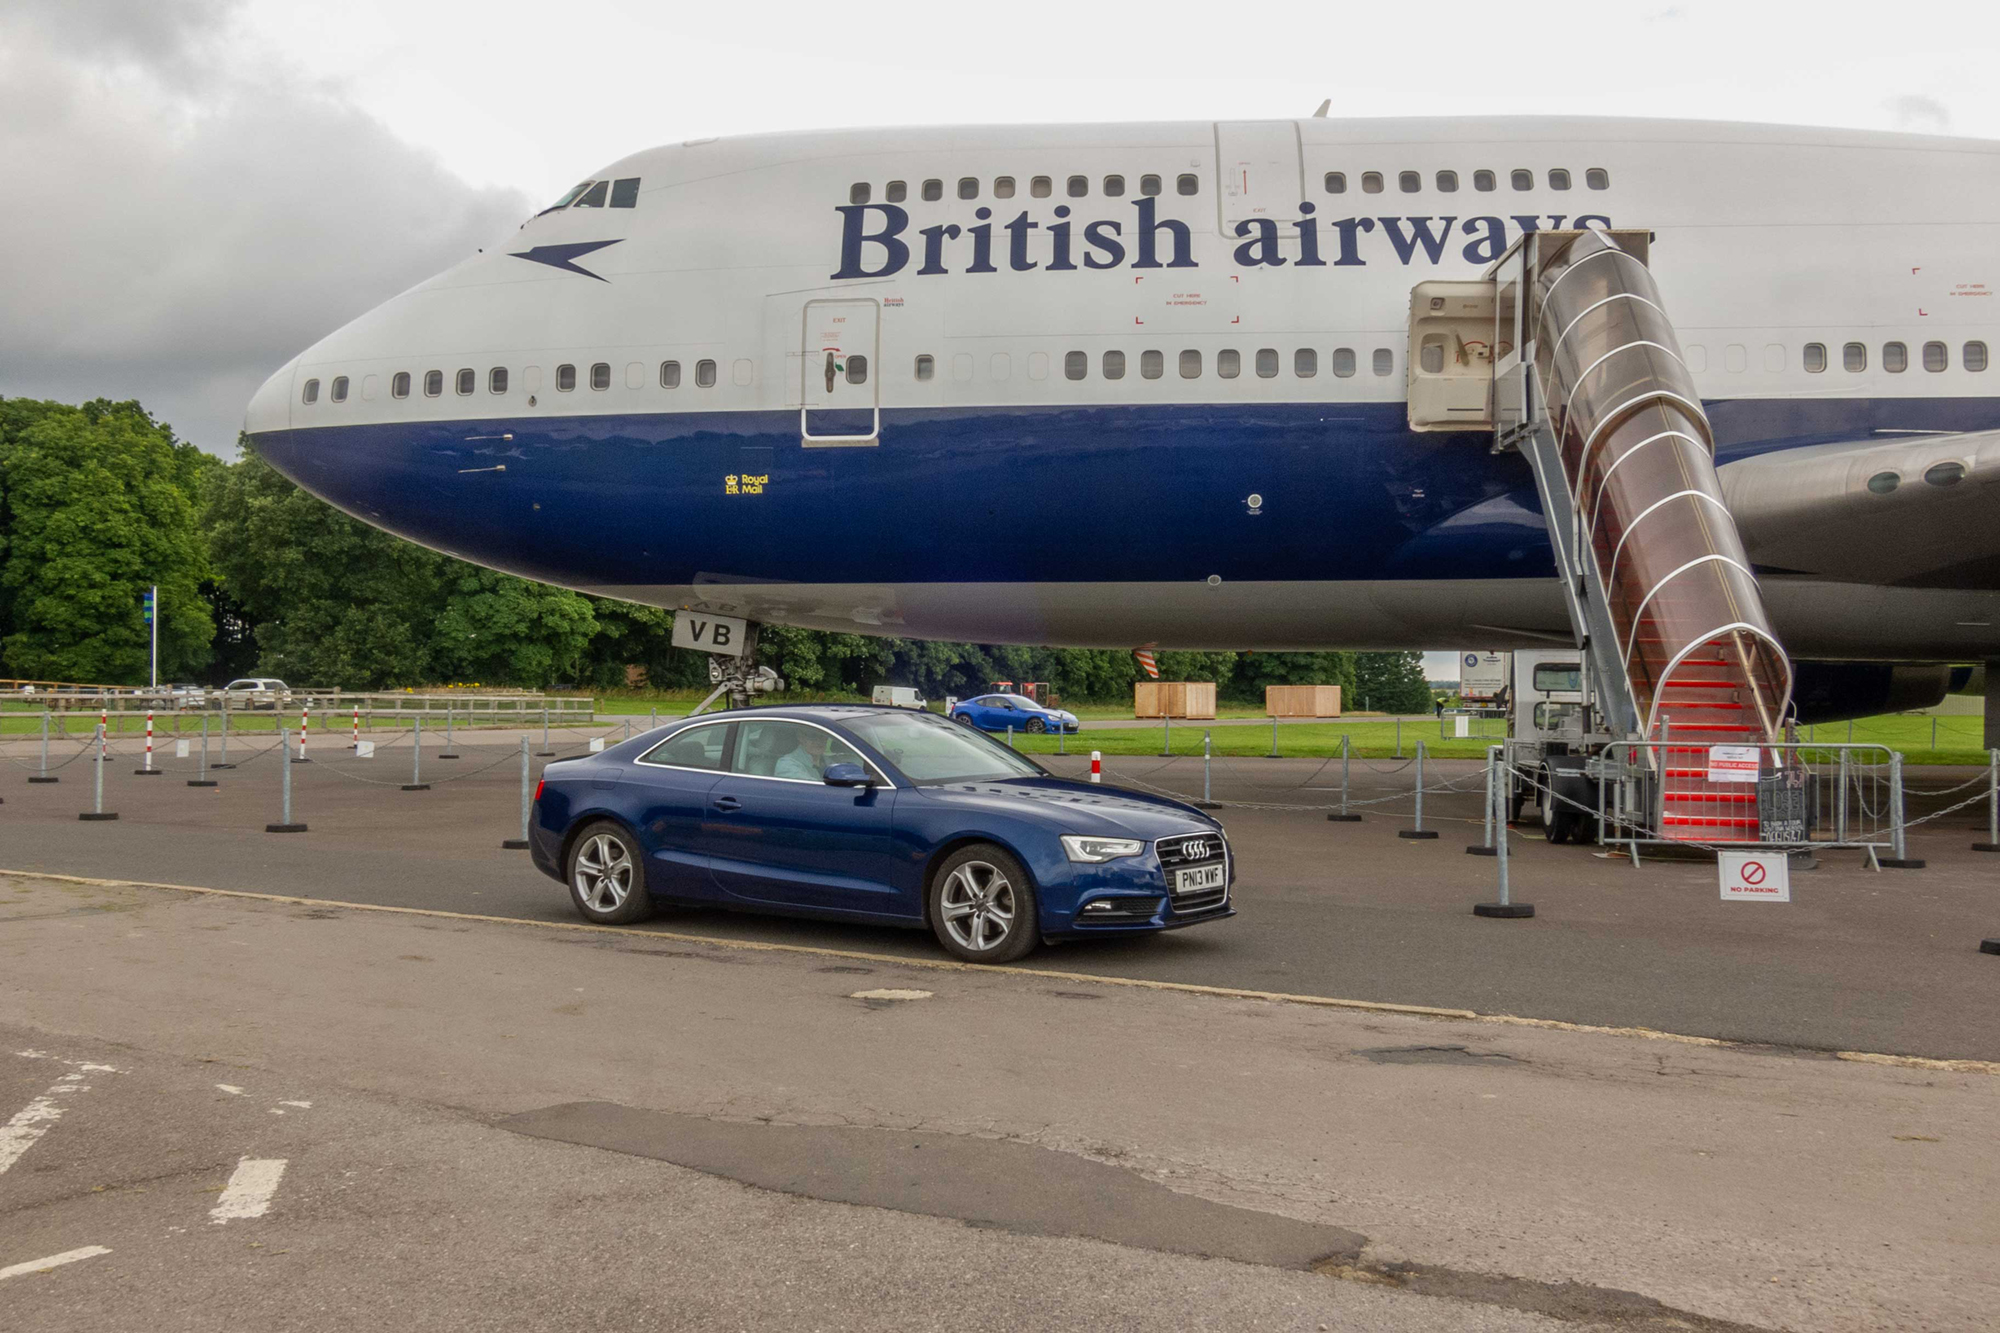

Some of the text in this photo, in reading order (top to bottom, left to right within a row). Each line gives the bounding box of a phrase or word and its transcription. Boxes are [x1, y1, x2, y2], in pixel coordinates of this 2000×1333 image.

[830, 196, 1612, 280] British airwa
[742, 474, 768, 485] Royal
[742, 485, 763, 494] Mail
[1182, 867, 1218, 888] PN13 WWF
